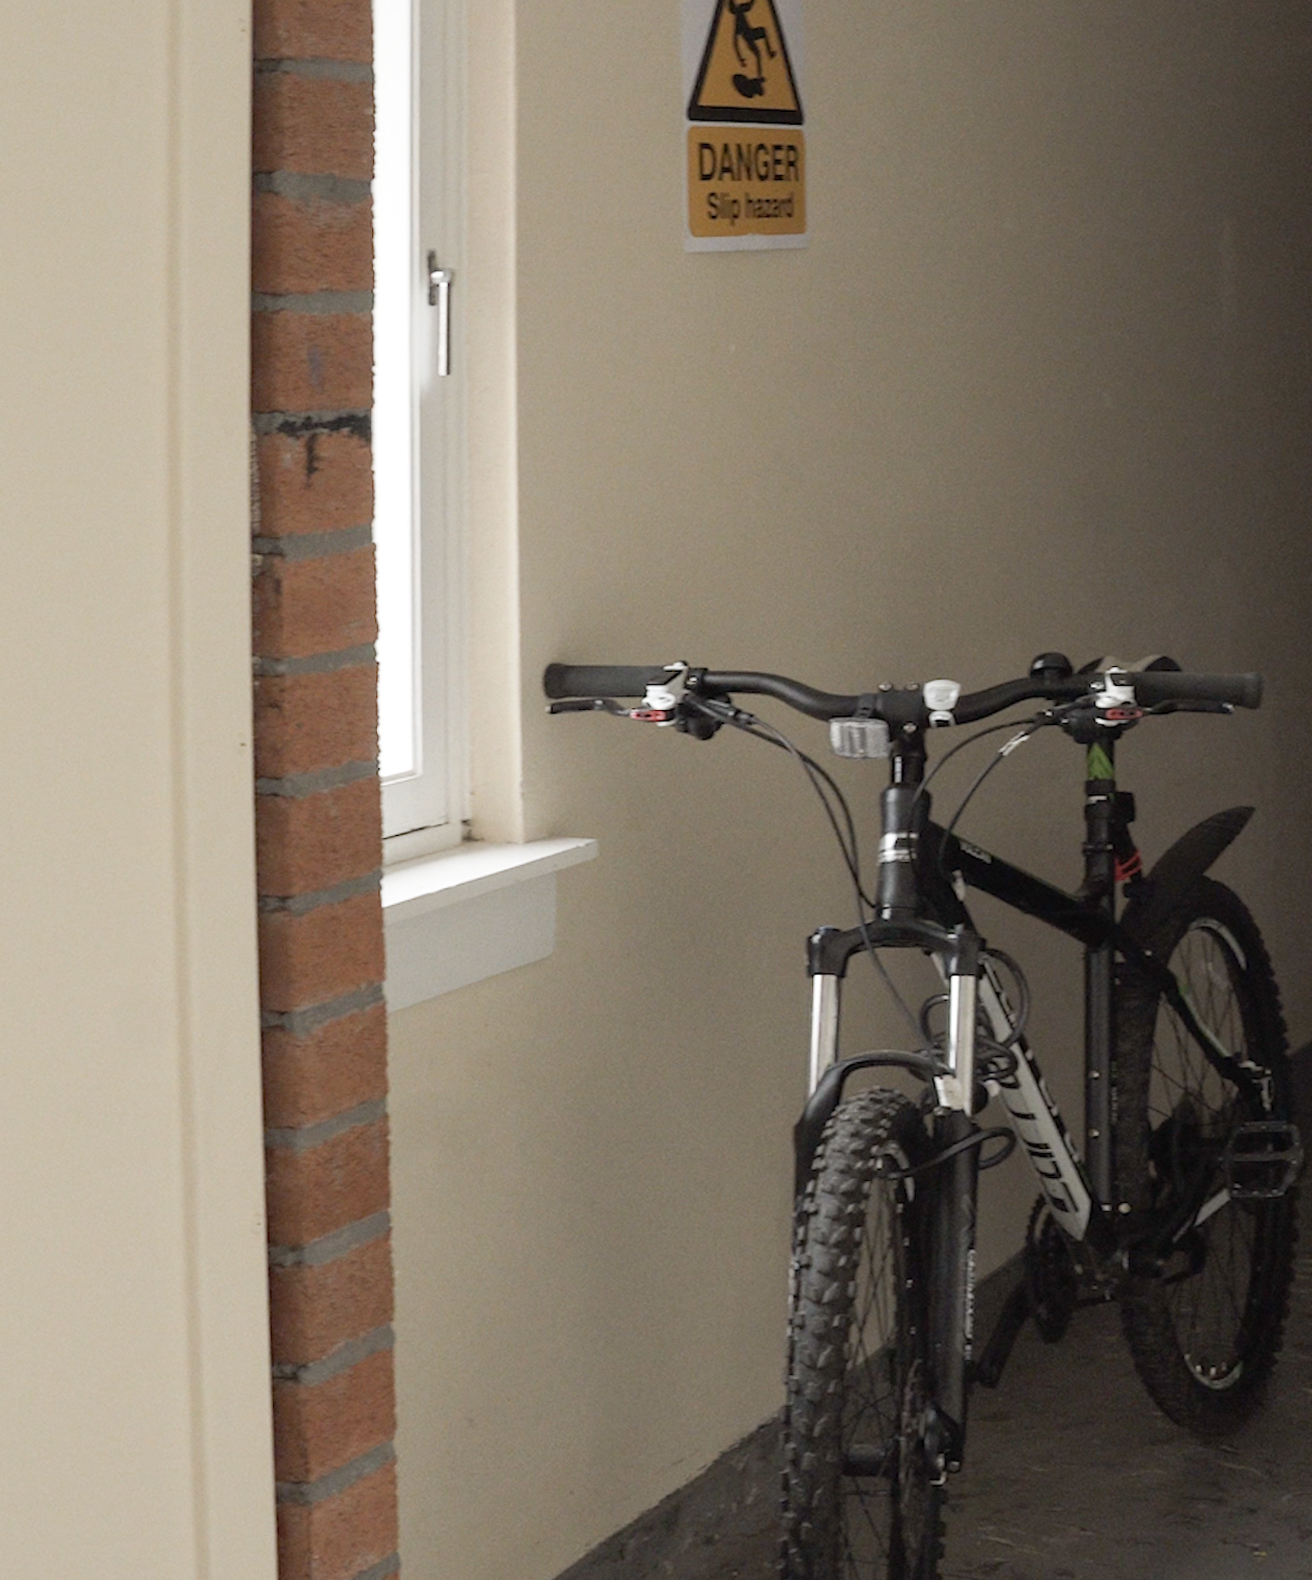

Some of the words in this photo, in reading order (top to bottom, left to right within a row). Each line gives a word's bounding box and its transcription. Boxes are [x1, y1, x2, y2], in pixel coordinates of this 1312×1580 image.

[699, 143, 799, 181] DANGER
[707, 192, 740, 226] Slip
[744, 192, 795, 218] hazard
